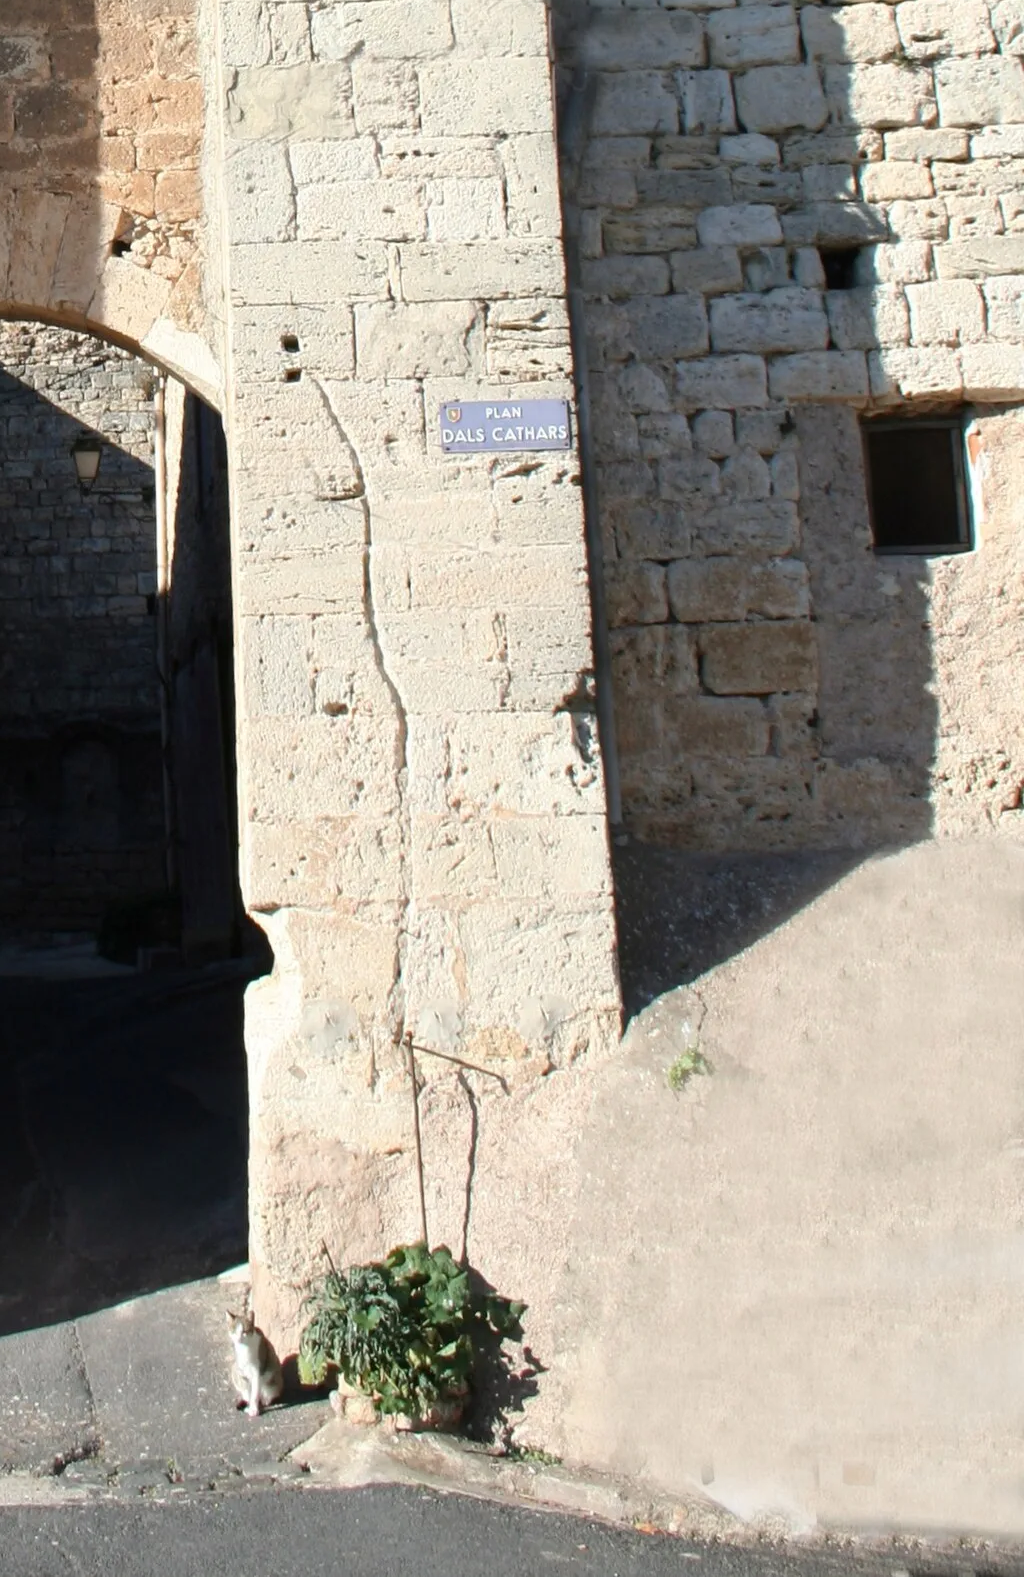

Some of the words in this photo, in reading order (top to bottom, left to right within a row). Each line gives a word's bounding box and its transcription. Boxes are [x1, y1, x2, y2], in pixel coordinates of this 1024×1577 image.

[485, 407, 522, 419] PLAN
[442, 428, 485, 443] DALS
[492, 425, 567, 441] CATHARS
